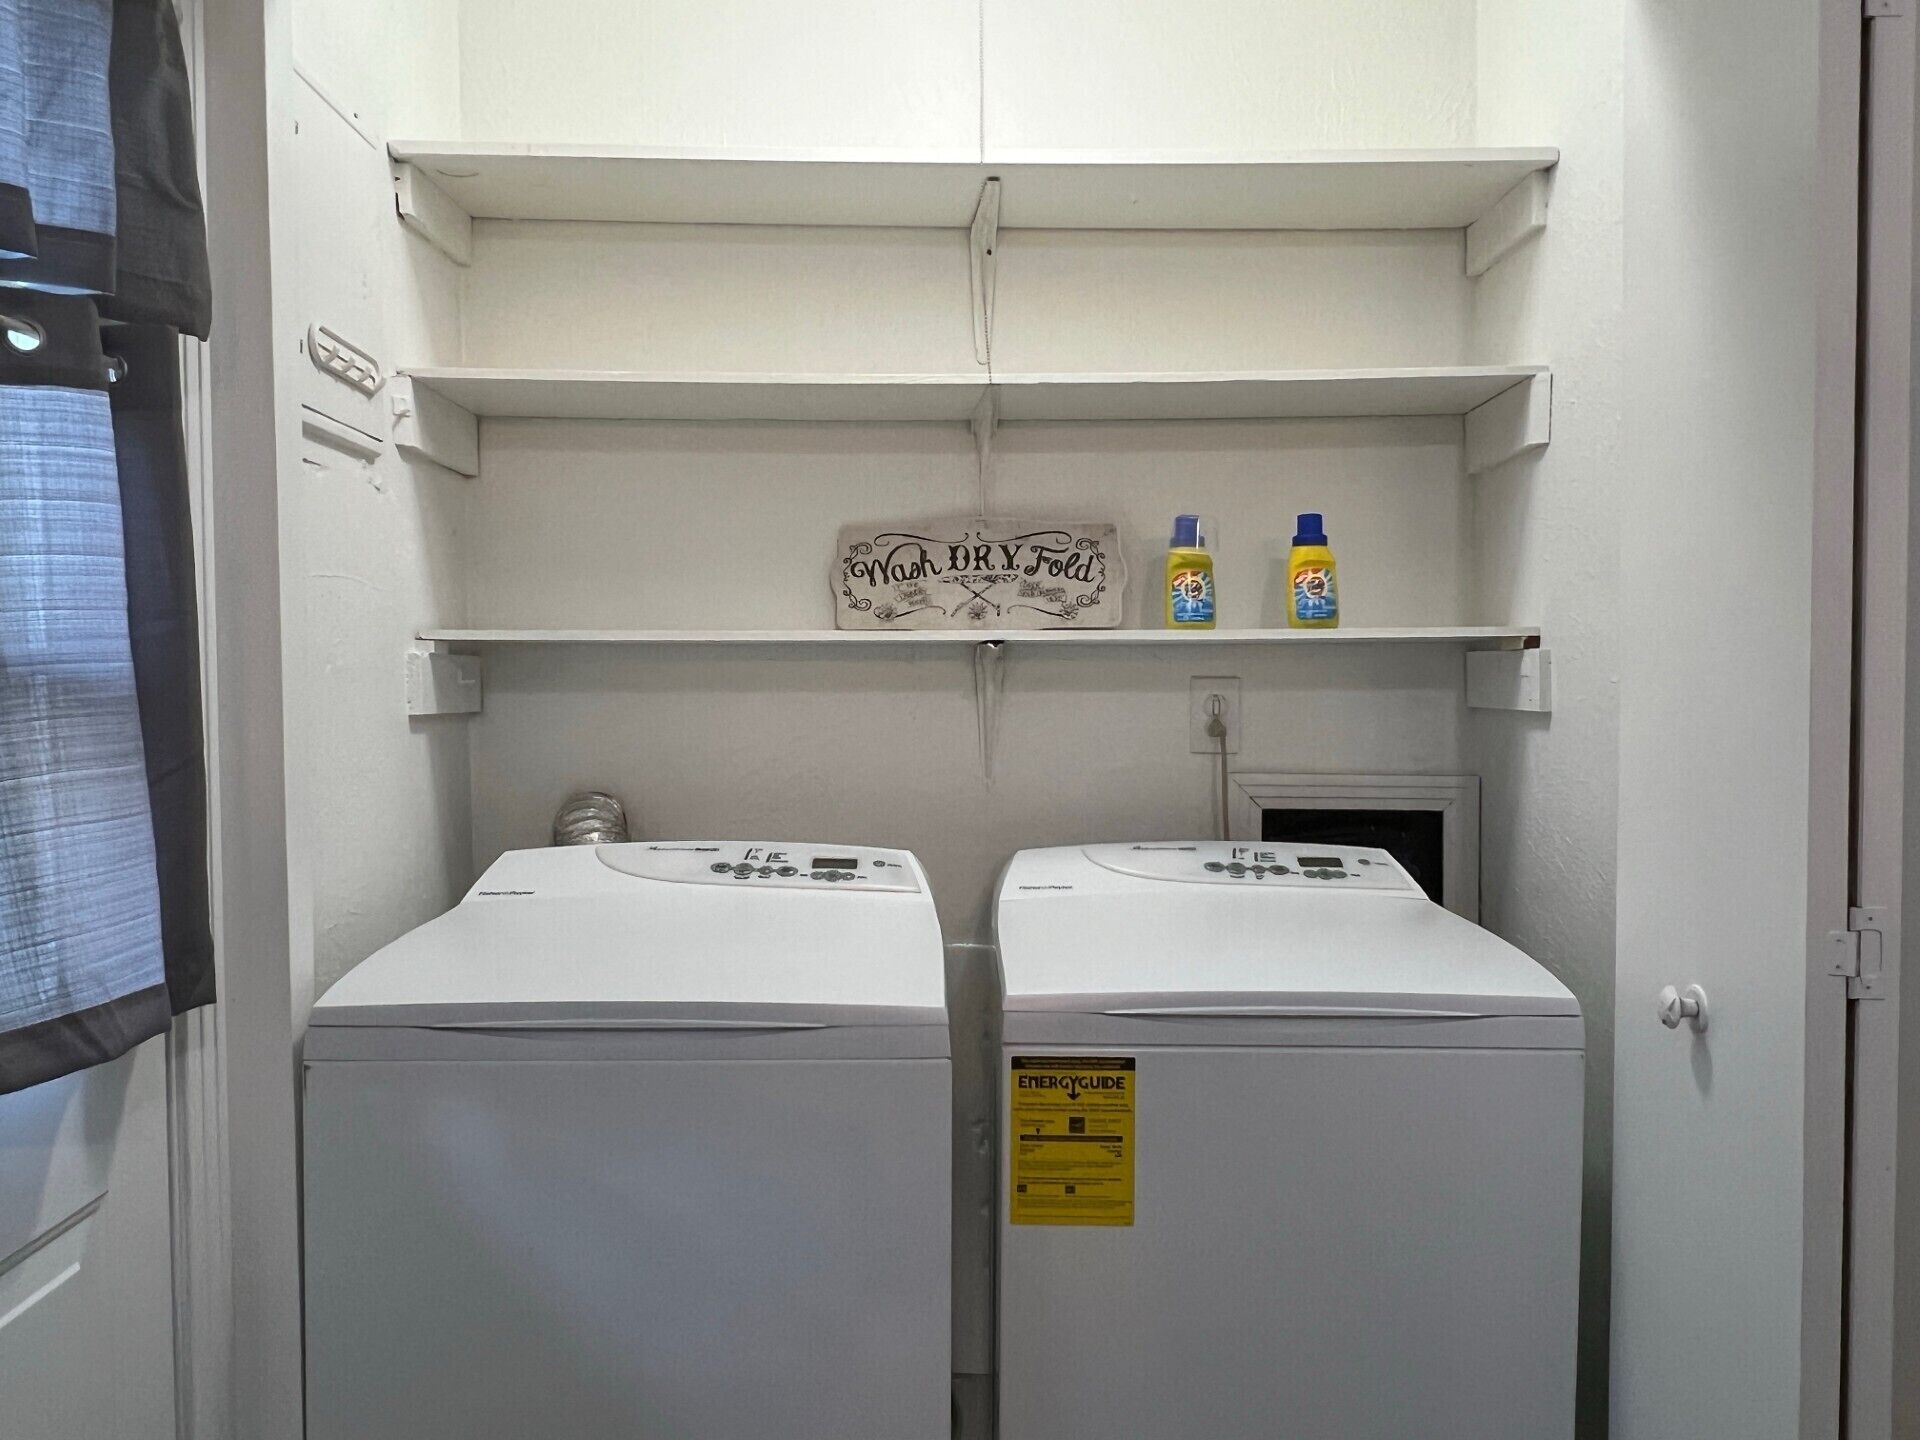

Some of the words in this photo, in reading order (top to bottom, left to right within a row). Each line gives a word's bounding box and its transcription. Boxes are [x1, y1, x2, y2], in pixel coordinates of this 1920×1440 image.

[850, 542, 942, 586] Wash
[947, 544, 1022, 571] DRY
[1024, 545, 1096, 583] Fold
[1018, 1075, 1126, 1090] ENERGYGUIDE
